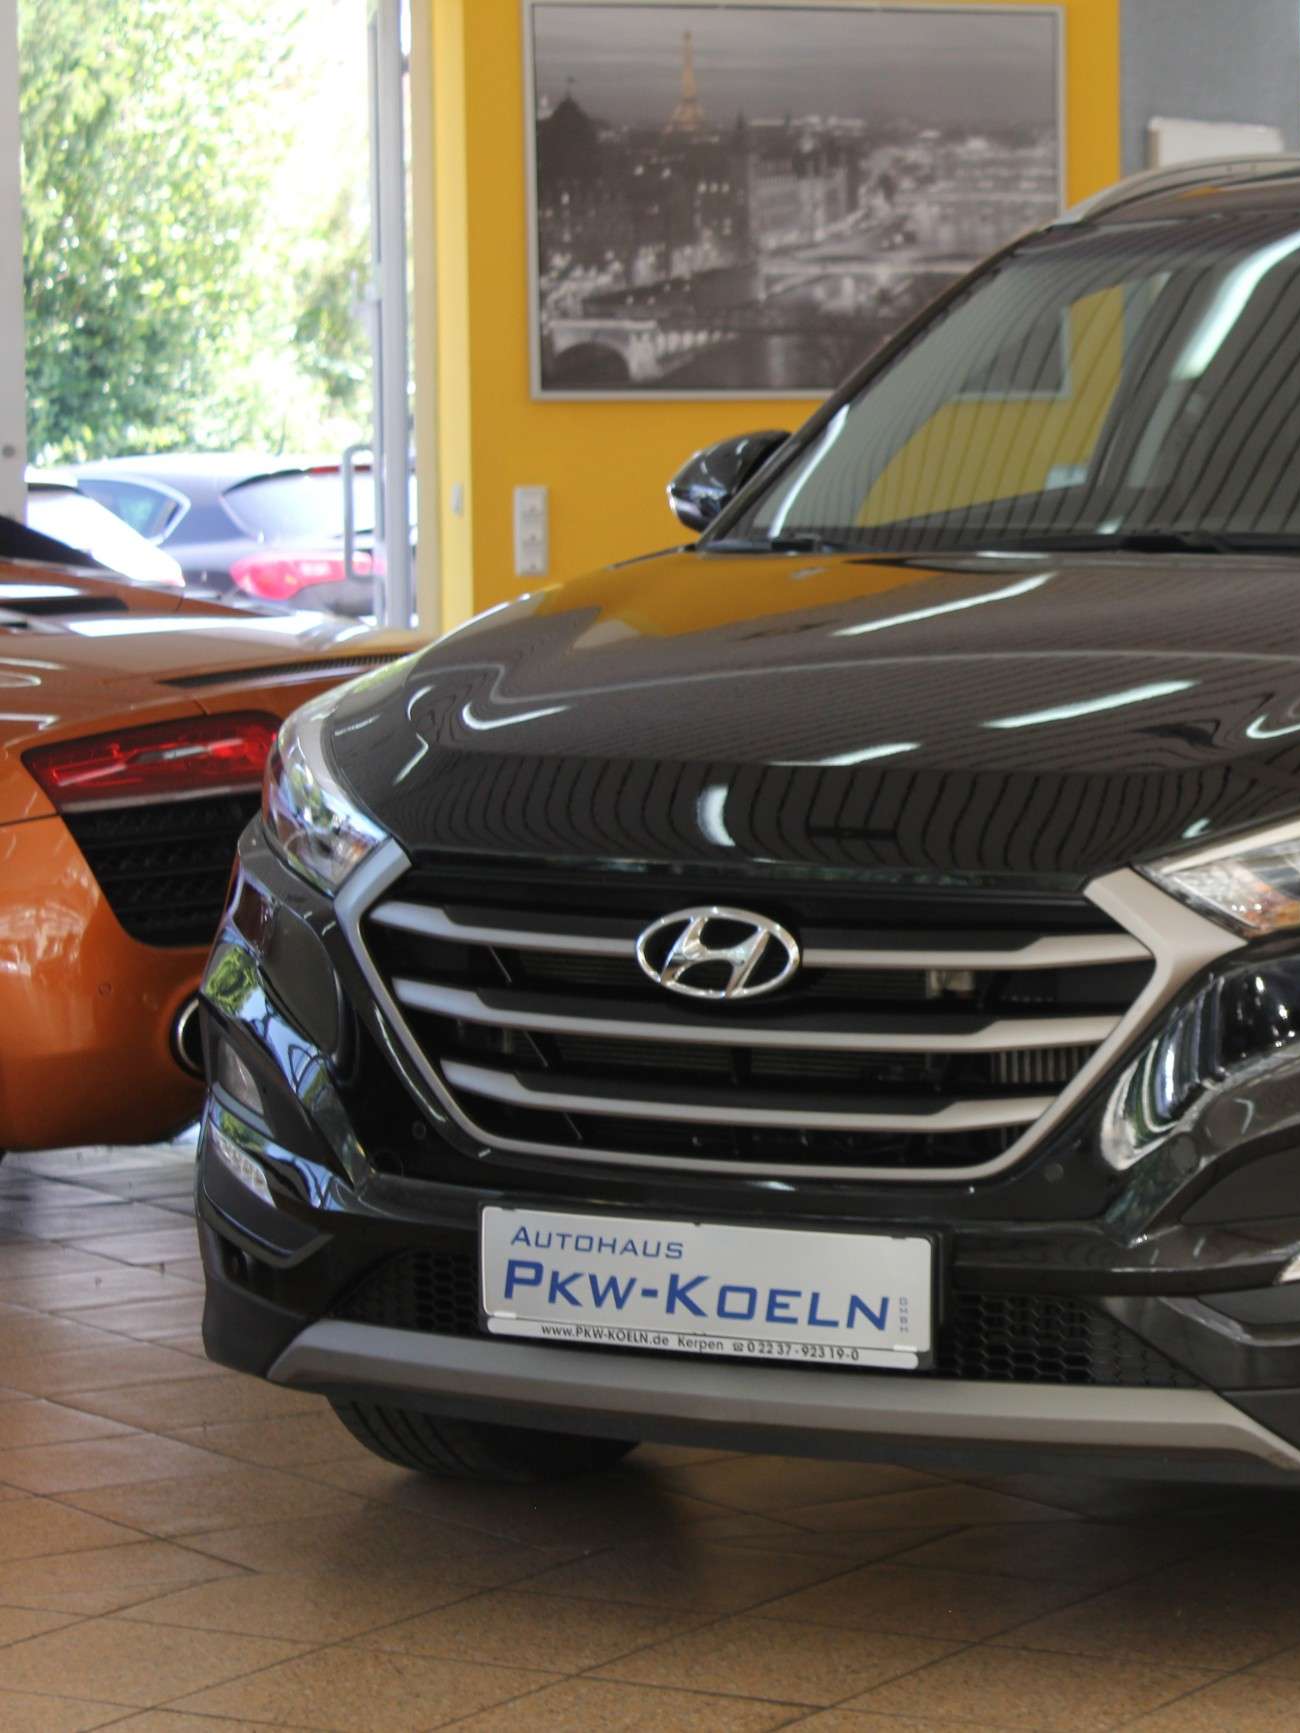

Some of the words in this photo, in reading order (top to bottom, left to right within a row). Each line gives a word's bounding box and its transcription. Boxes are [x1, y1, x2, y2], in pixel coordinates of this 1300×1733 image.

[511, 1226, 684, 1260] AUTOHAUS
[503, 1258, 890, 1331] PKW-KOELN
[540, 1323, 670, 1346] www.PKW-KOELN.de
[677, 1335, 724, 1352] Kerpen
